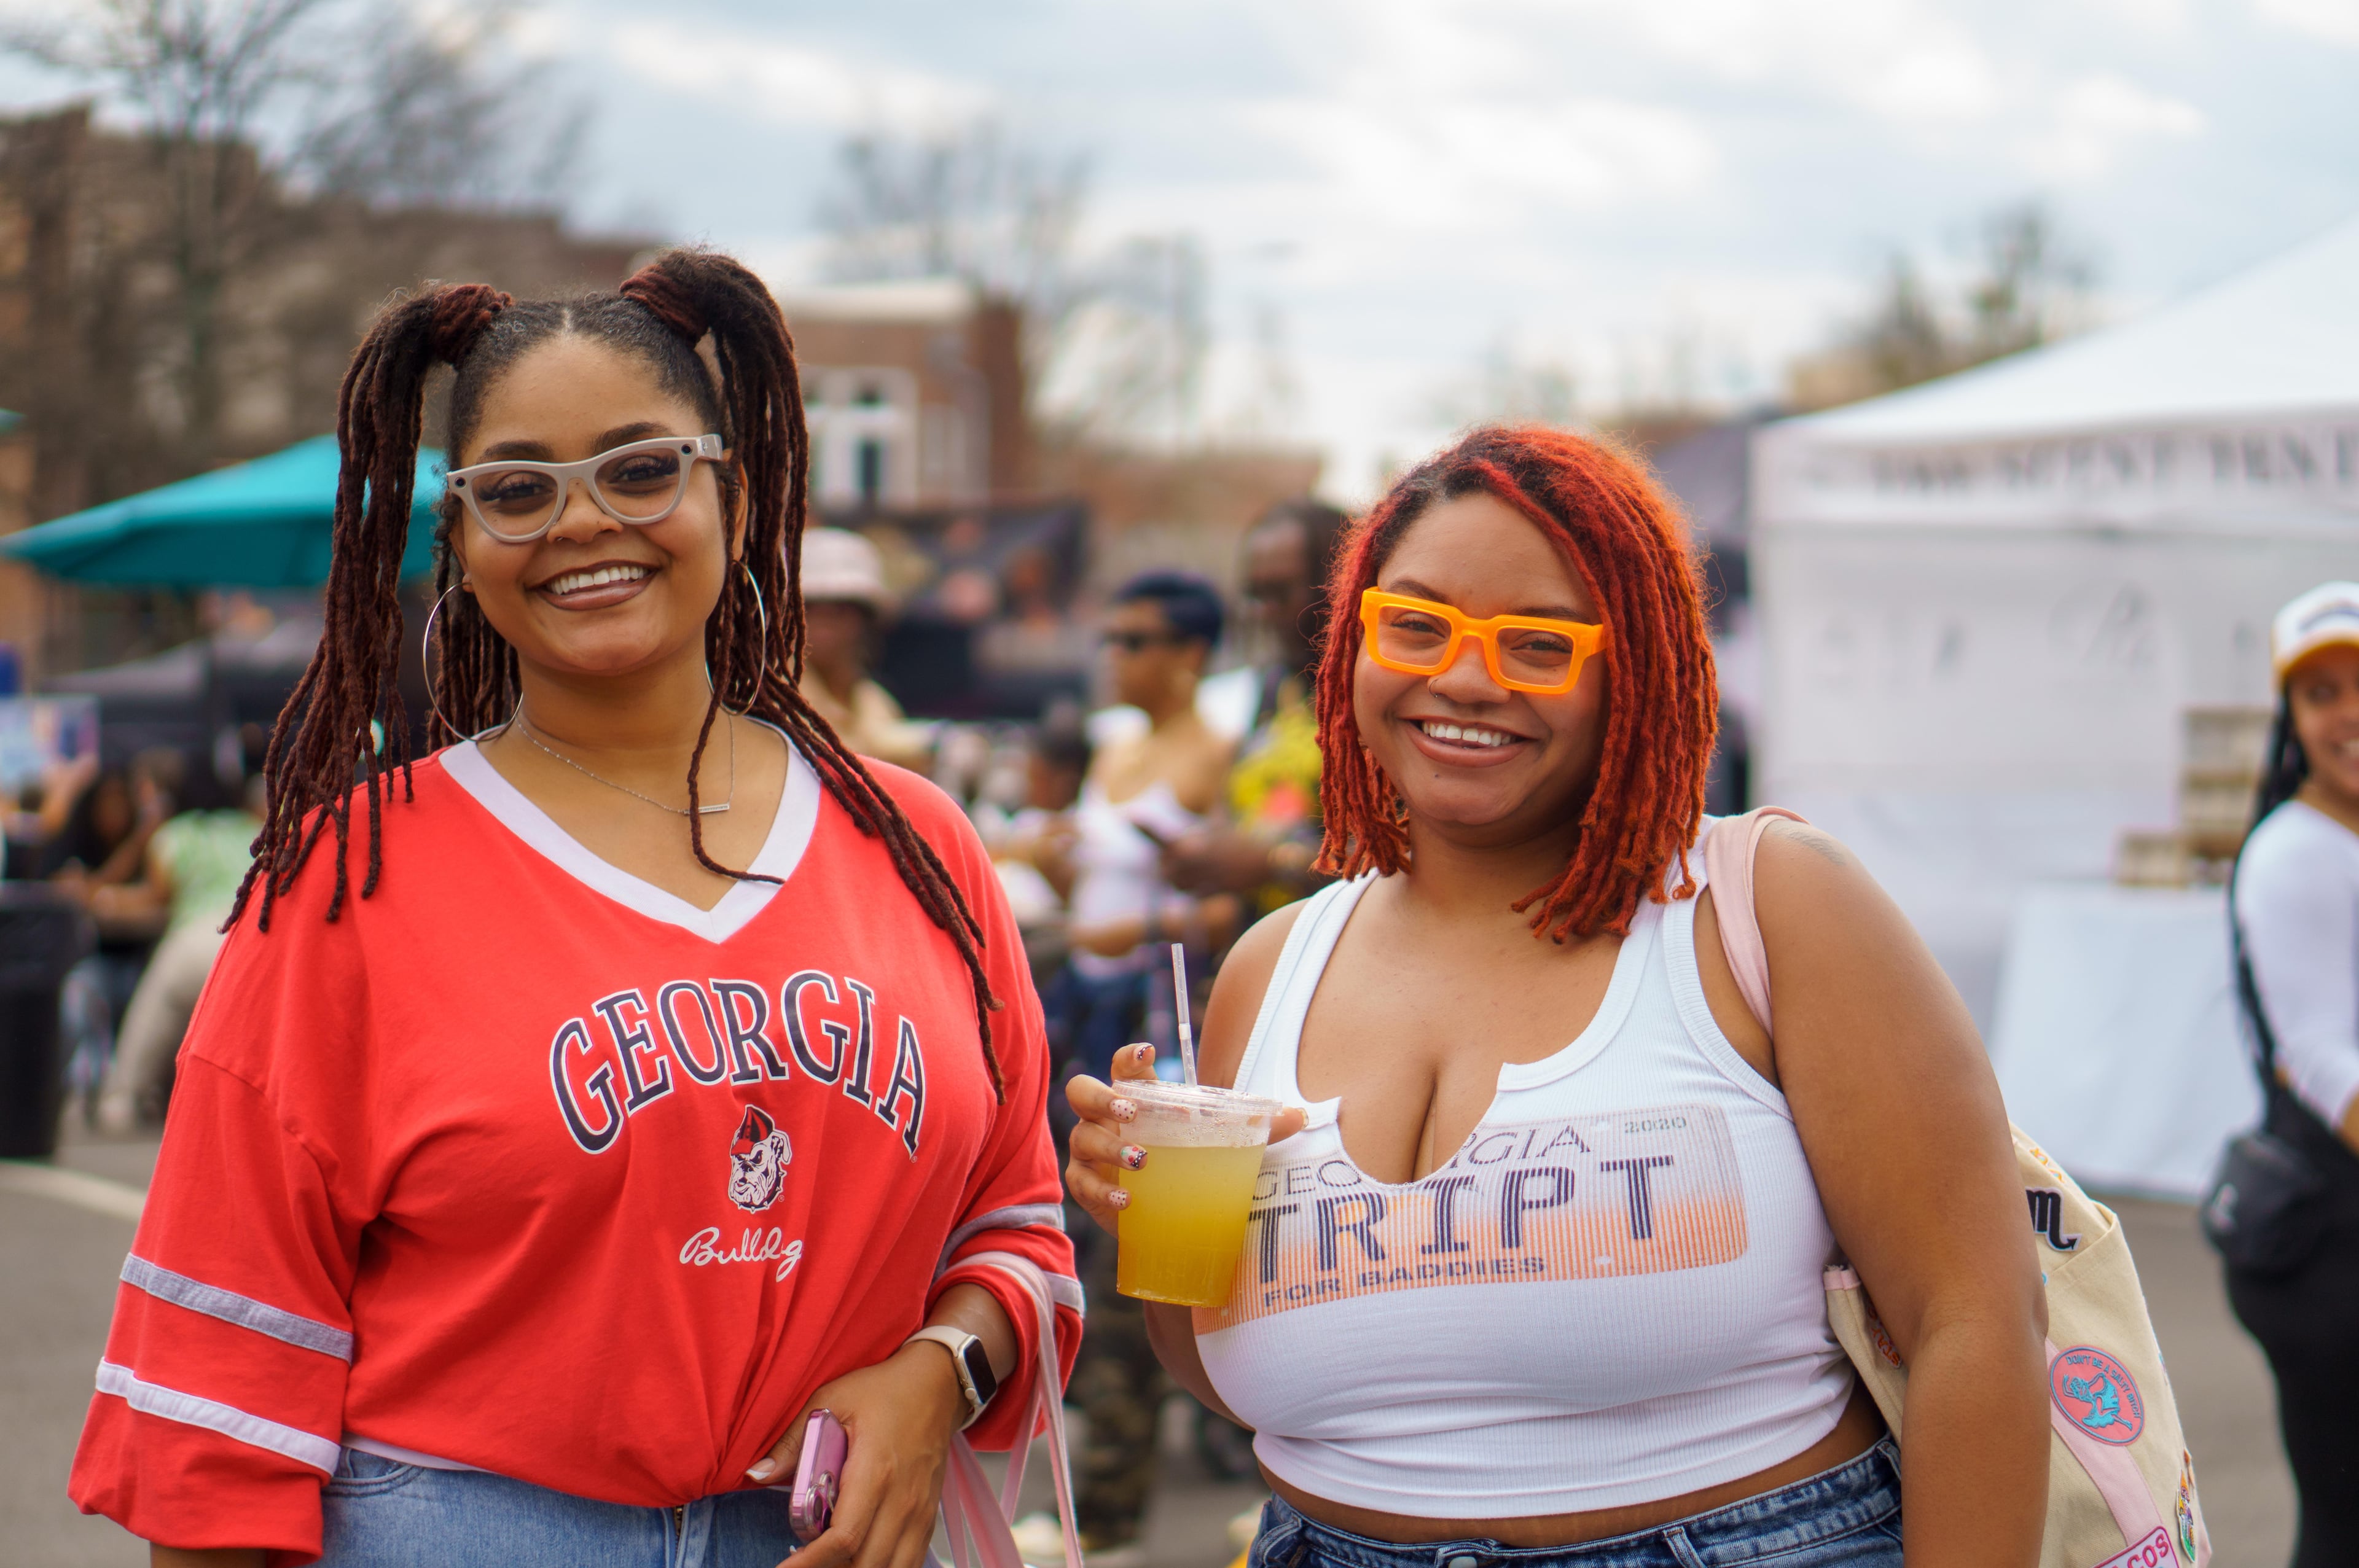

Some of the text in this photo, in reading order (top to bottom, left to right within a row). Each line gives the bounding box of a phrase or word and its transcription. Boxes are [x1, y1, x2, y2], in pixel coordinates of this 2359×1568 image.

[549, 969, 925, 1160] GEORGIA
[1624, 1116, 1687, 1134] 2020
[1248, 1155, 1674, 1284] TRIPT
[1265, 1257, 1547, 1307] FOR BADDIES
[2065, 1355, 2141, 1418] DON'T BE A SALTY BITCH
[2111, 1534, 2169, 1568] COS
